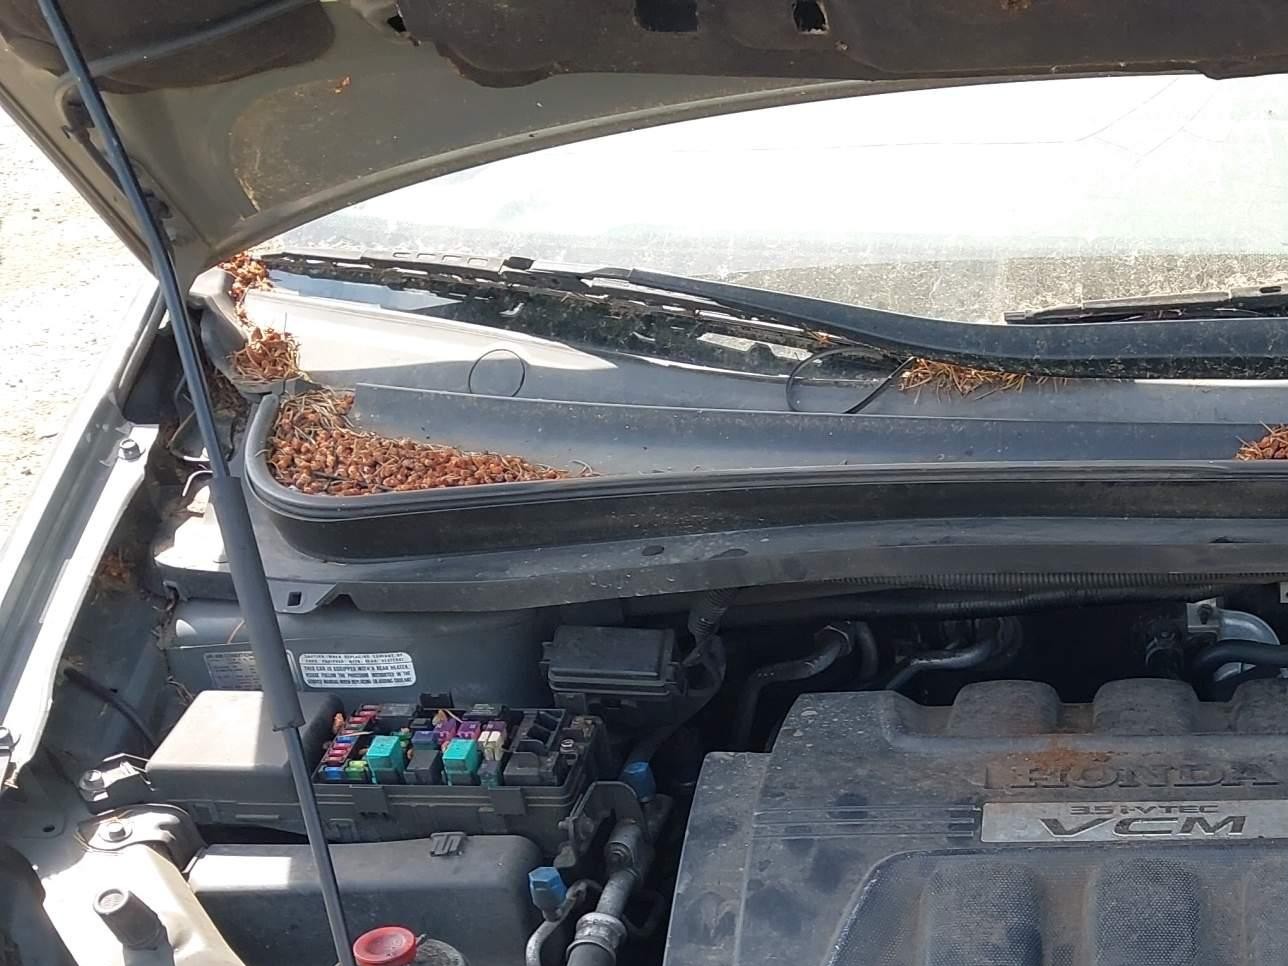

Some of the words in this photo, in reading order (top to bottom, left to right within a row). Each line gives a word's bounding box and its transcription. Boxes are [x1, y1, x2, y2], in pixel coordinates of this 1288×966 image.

[1011, 764, 1280, 788] HONDA
[1070, 805, 1112, 815] 3.5
[1120, 805, 1219, 815] i-VTEC
[1040, 815, 1247, 837] VCM
